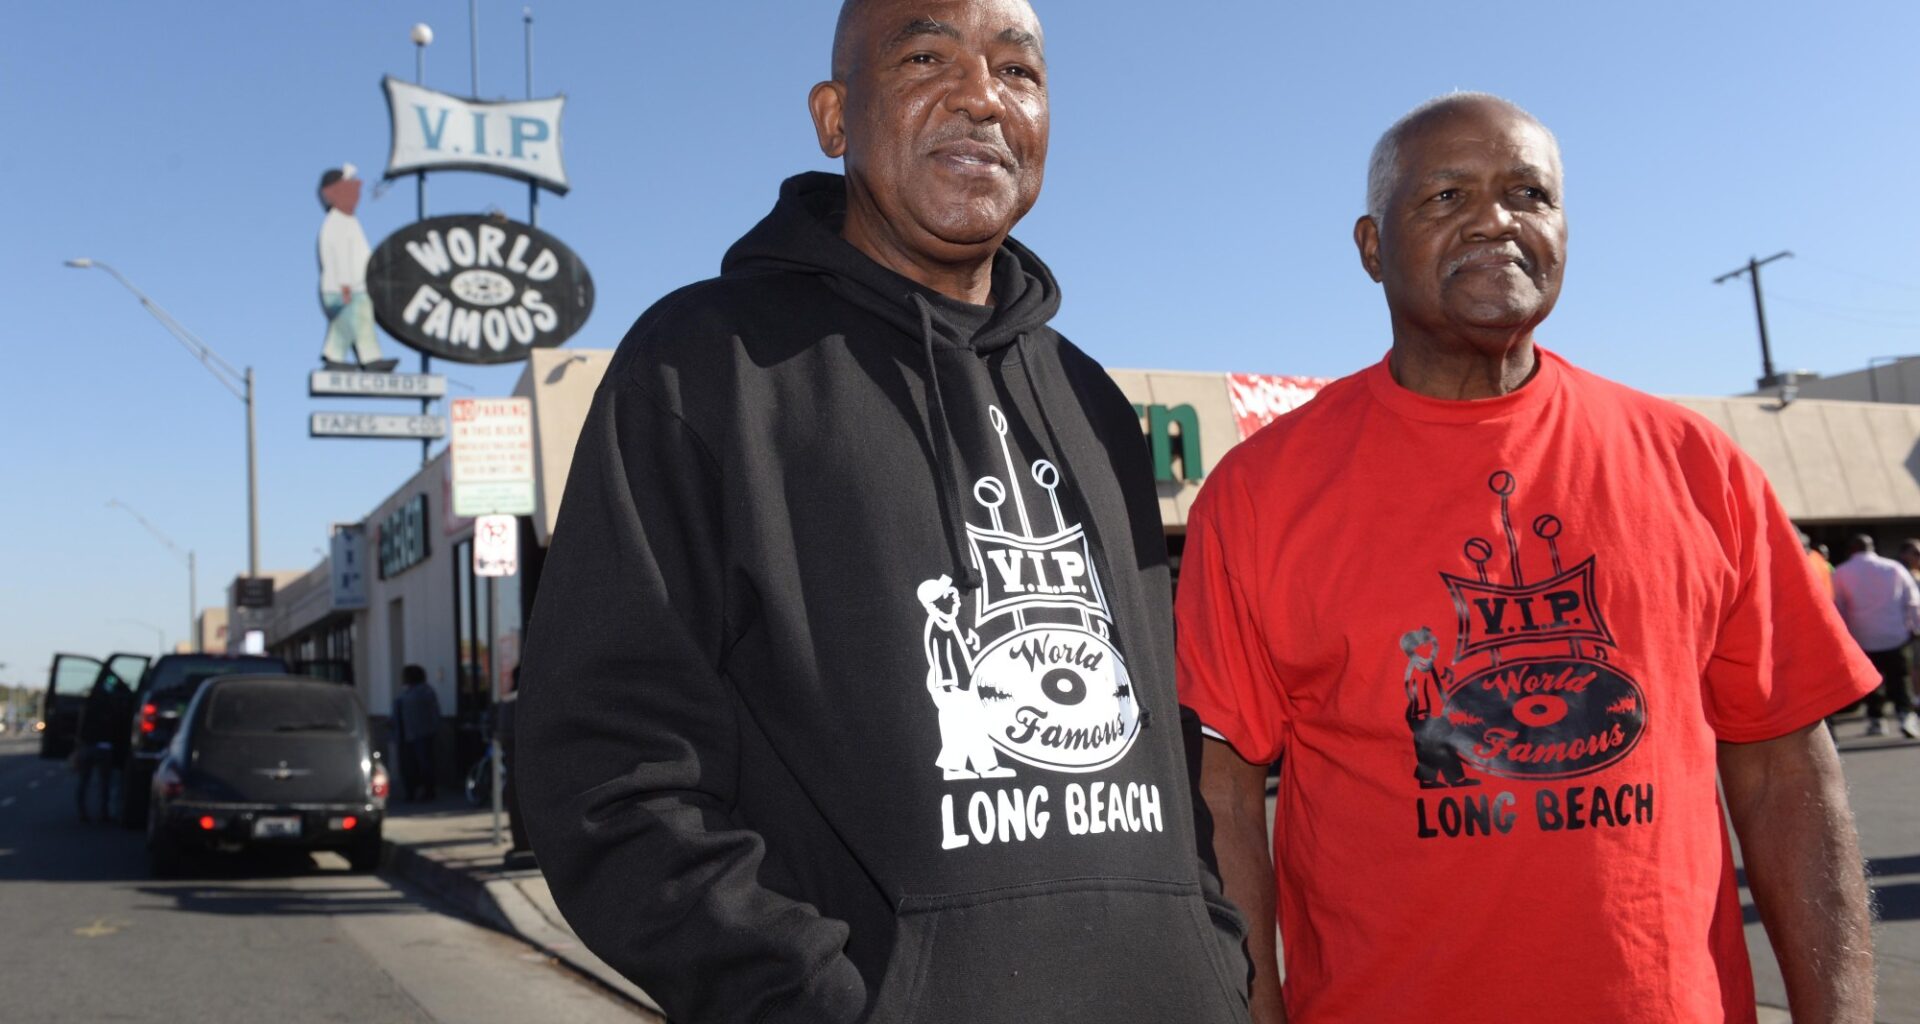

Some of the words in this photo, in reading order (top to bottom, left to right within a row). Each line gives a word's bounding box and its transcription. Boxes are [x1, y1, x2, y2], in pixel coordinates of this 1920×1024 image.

[413, 105, 550, 161] V.I.P.
[405, 223, 560, 282] WORLD
[402, 284, 559, 352] FAMOUS
[329, 373, 430, 390] RECORDS
[319, 416, 377, 433] TAPES
[987, 549, 1087, 593] V.I.P.
[1473, 590, 1582, 635] V.I.P.
[1009, 633, 1103, 672] World
[1482, 665, 1598, 699] World
[1005, 705, 1125, 750] Famous
[1472, 722, 1625, 763] Famous
[941, 785, 1050, 850] LONG
[1065, 781, 1164, 835] BEACH
[1416, 791, 1517, 839] LONG
[1535, 782, 1654, 831] BEACH
